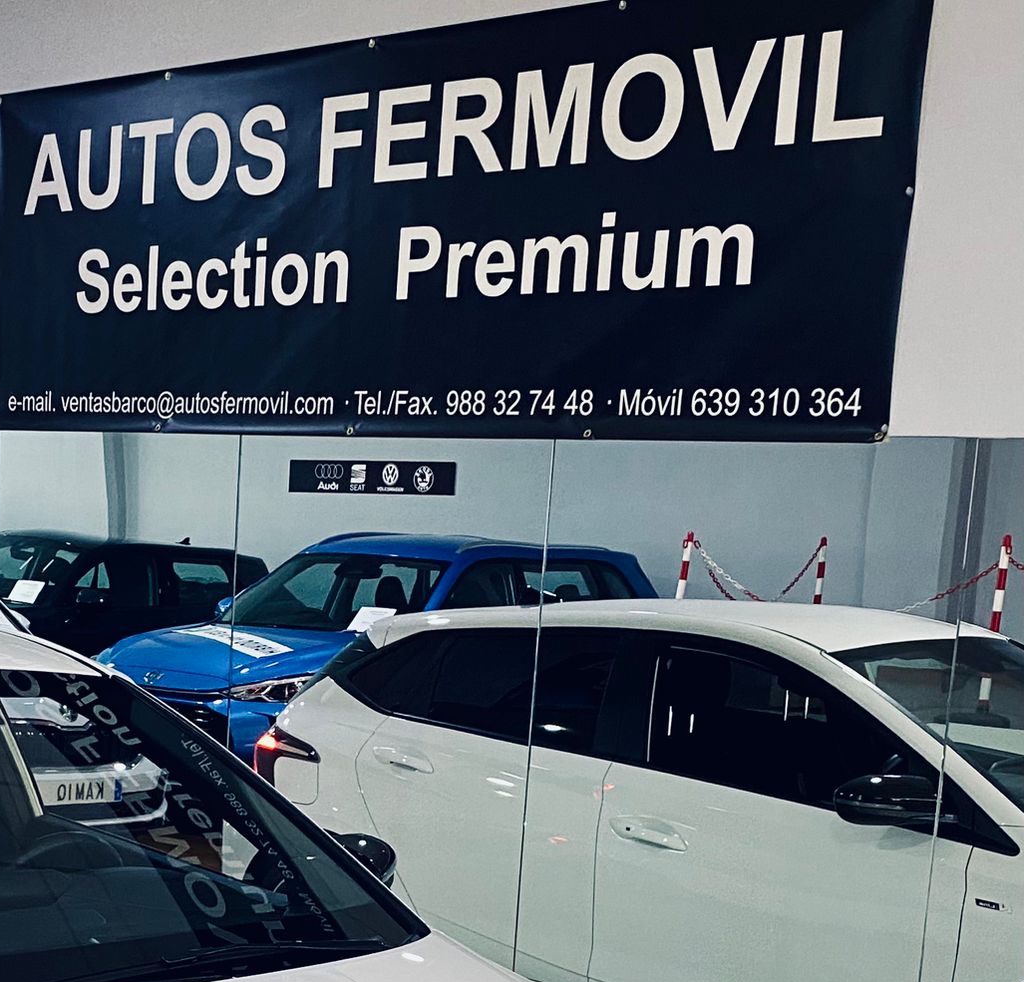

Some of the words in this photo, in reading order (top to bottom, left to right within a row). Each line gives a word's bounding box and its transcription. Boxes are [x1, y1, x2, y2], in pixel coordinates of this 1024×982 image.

[23, 104, 287, 216] AUTOS
[318, 29, 884, 189] FERMOVIL
[76, 237, 350, 314] Selection
[395, 212, 755, 300] Premium
[8, 390, 56, 413] e-mail.
[61, 390, 334, 419] ventasbarco@autosfermovil.com
[354, 390, 438, 416] Tel./Fax.
[445, 389, 486, 416] 988
[493, 389, 521, 416] 32
[528, 389, 556, 416] 74
[563, 389, 594, 416] 48
[618, 388, 683, 417] Móvil
[690, 387, 741, 417] 639
[748, 387, 801, 417] 310
[809, 387, 862, 417] 364
[317, 481, 339, 490] Audi
[349, 484, 366, 492] SEAT
